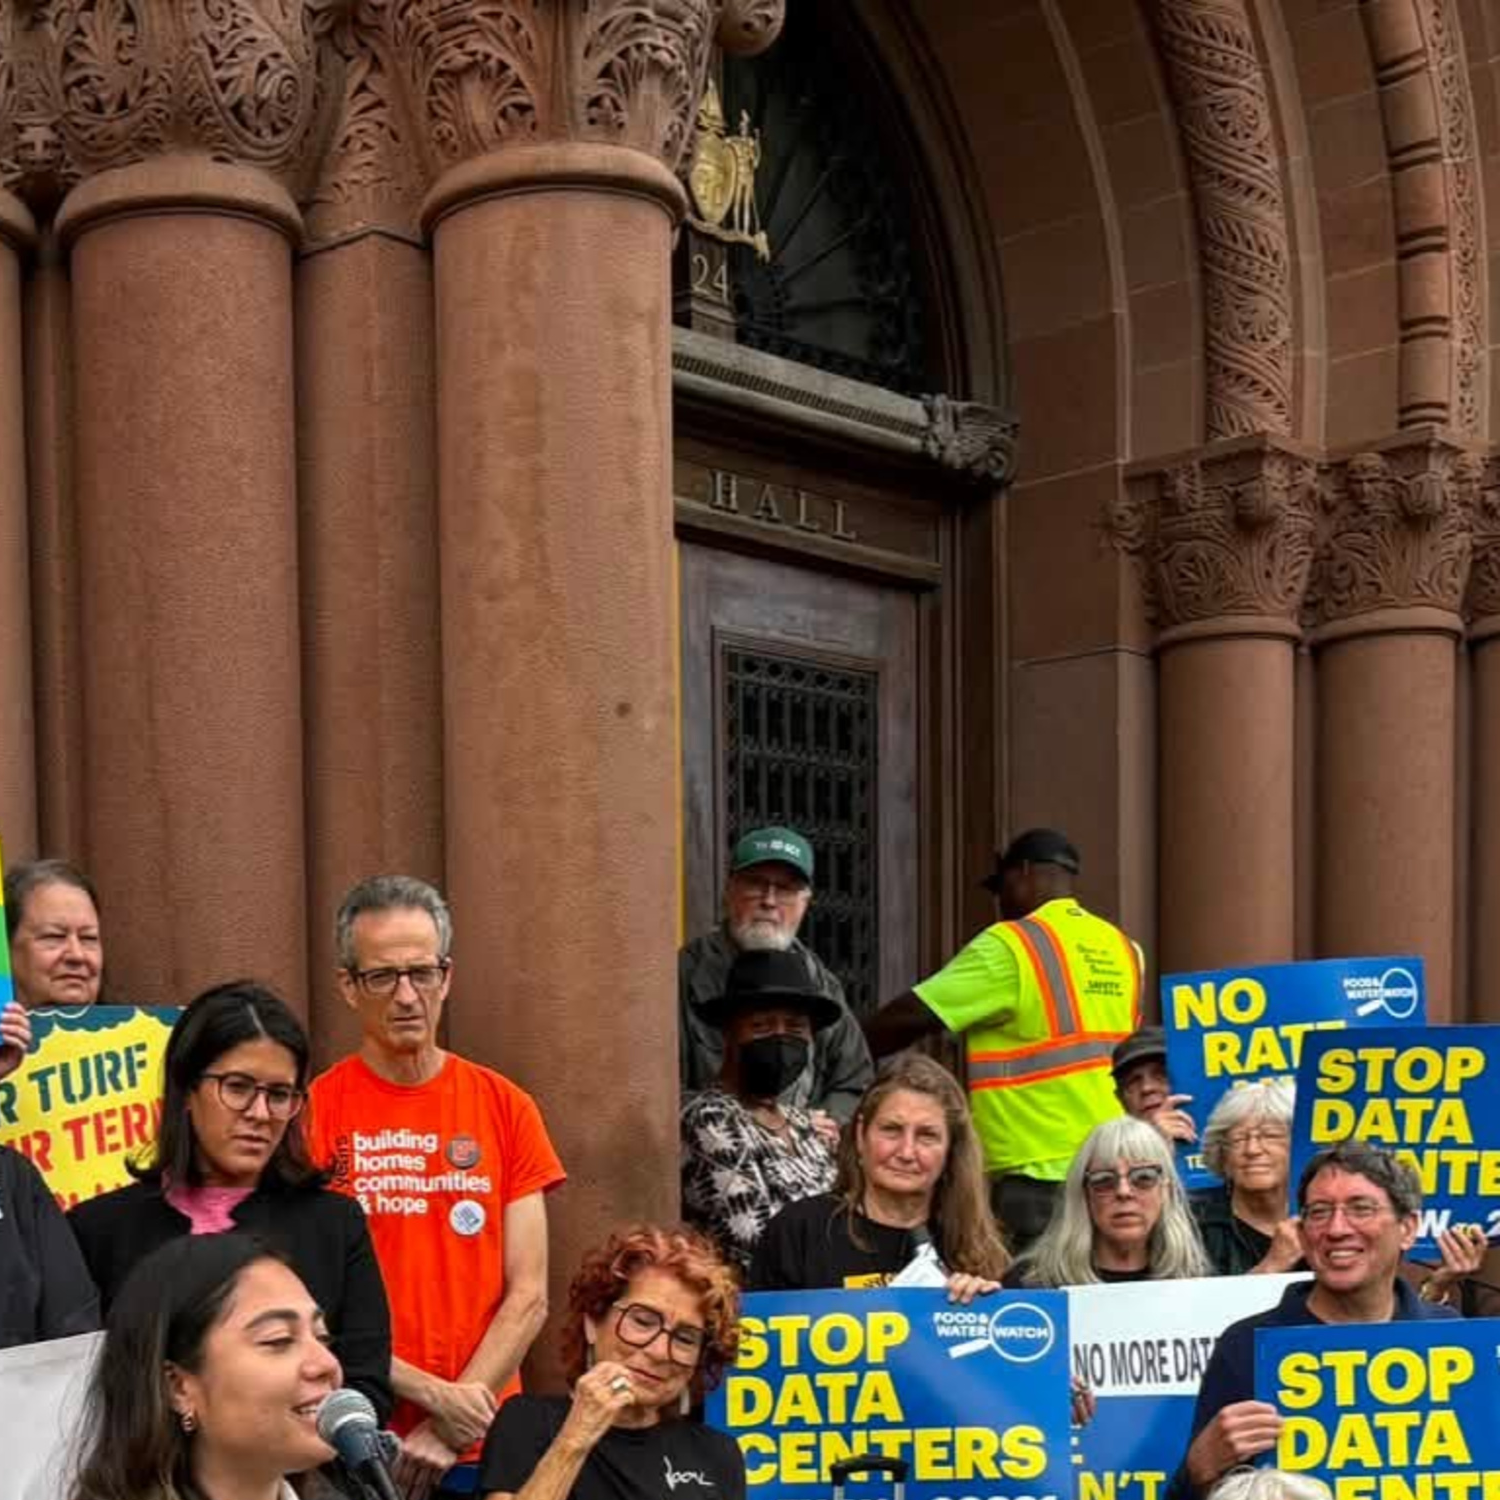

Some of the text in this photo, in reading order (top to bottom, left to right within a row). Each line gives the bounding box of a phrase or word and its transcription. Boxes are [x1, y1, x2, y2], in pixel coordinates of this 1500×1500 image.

[692, 254, 729, 301] 24
[708, 469, 856, 540] HALL
[1172, 978, 1267, 1030] NO
[1203, 1020, 1347, 1078] RAT
[1316, 1047, 1485, 1094] STOP
[28, 1042, 147, 1112] TURF
[353, 1129, 438, 1153] building
[1311, 1098, 1473, 1144] DATA
[354, 1154, 426, 1171] homes
[354, 1172, 492, 1193] communities
[376, 1194, 428, 1215] hope
[736, 1311, 910, 1369] STOP
[936, 1325, 1049, 1338] WATER WATCH
[1073, 1342, 1105, 1389] NO
[1111, 1338, 1170, 1386] MORE
[1277, 1346, 1475, 1409] STOP
[725, 1371, 904, 1427] DATA
[1276, 1410, 1473, 1471] DATA
